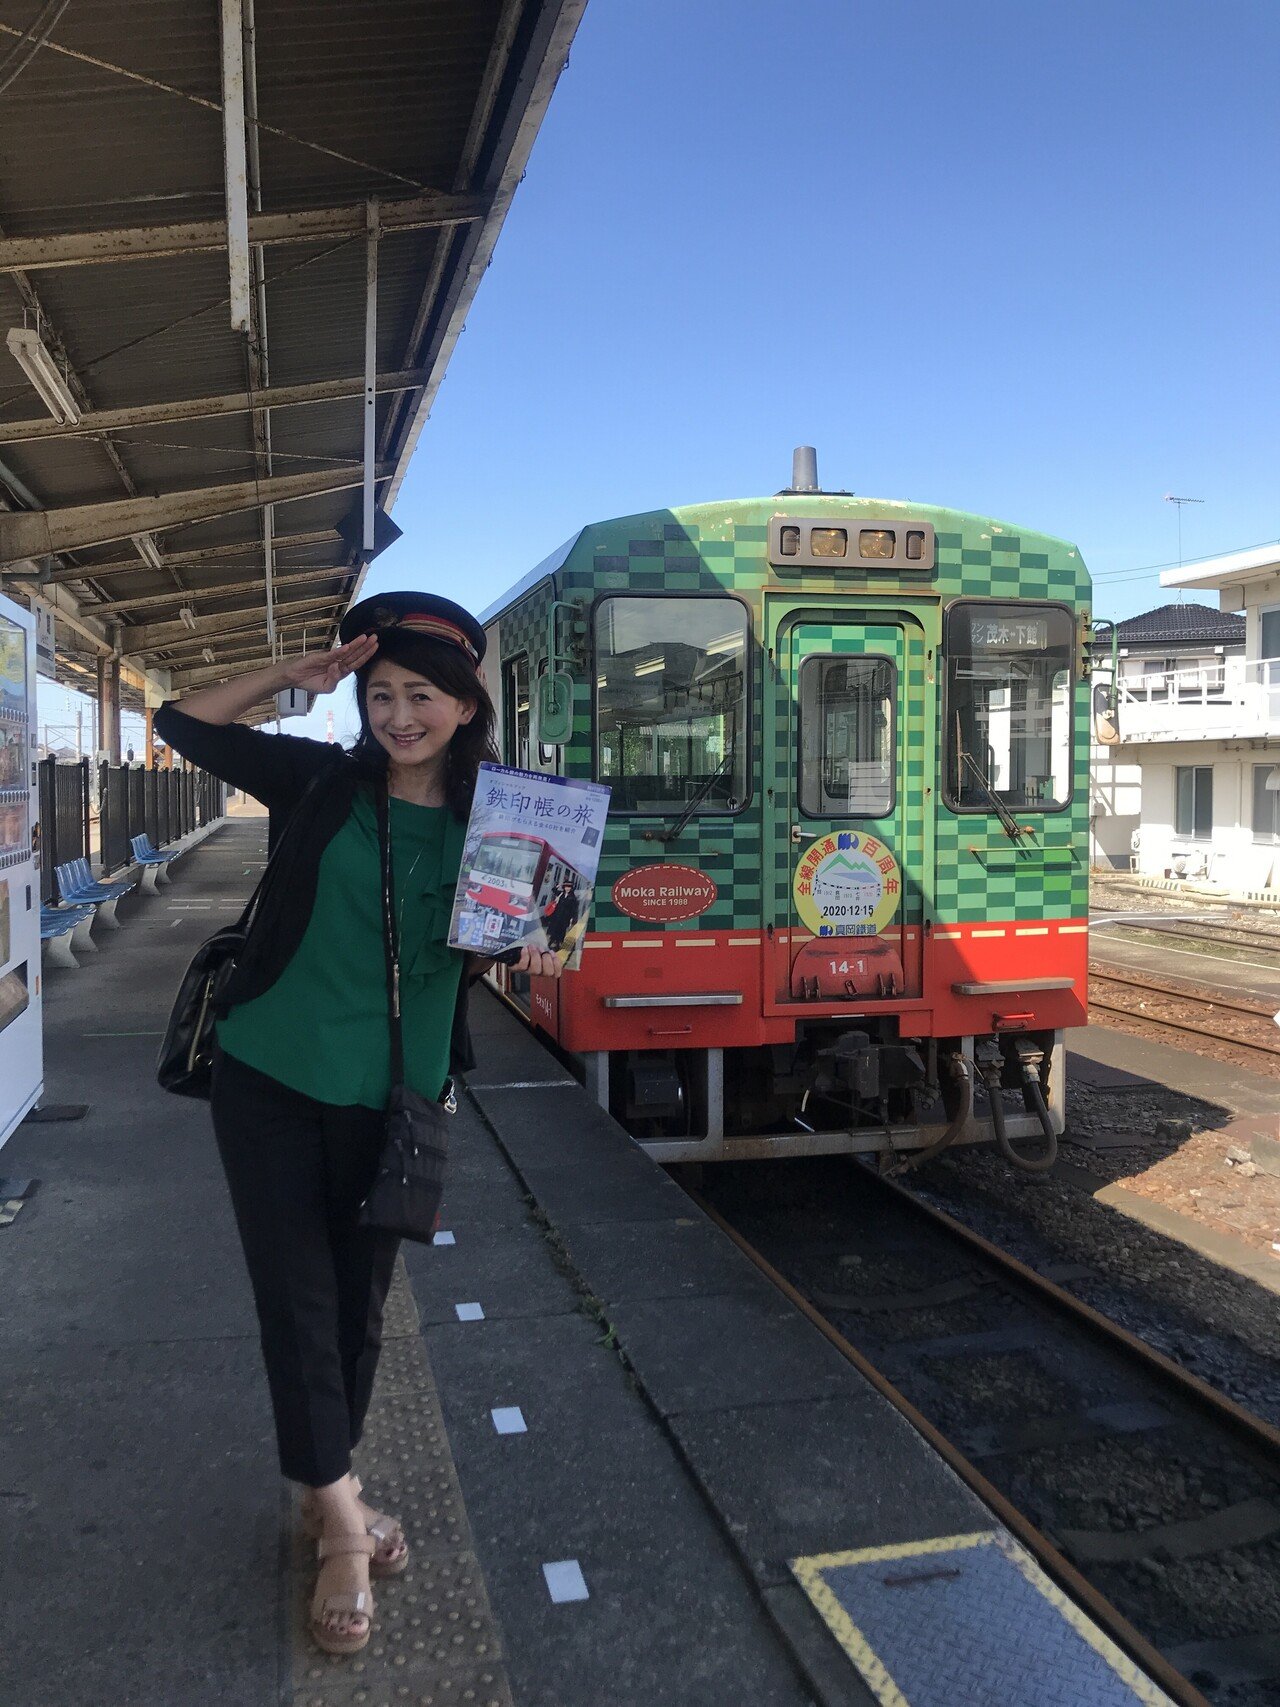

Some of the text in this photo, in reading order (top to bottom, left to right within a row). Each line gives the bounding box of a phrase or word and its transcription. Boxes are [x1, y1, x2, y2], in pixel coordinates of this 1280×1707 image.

[987, 624, 1038, 645] 茂木 下館
[486, 786, 595, 827] 鉄印帳の旅
[797, 838, 838, 896] 全線開通
[861, 837, 900, 895] 百周年
[620, 886, 710, 899] Moka Railway
[669, 898, 688, 906] 1988
[829, 959, 864, 975] 14-1
